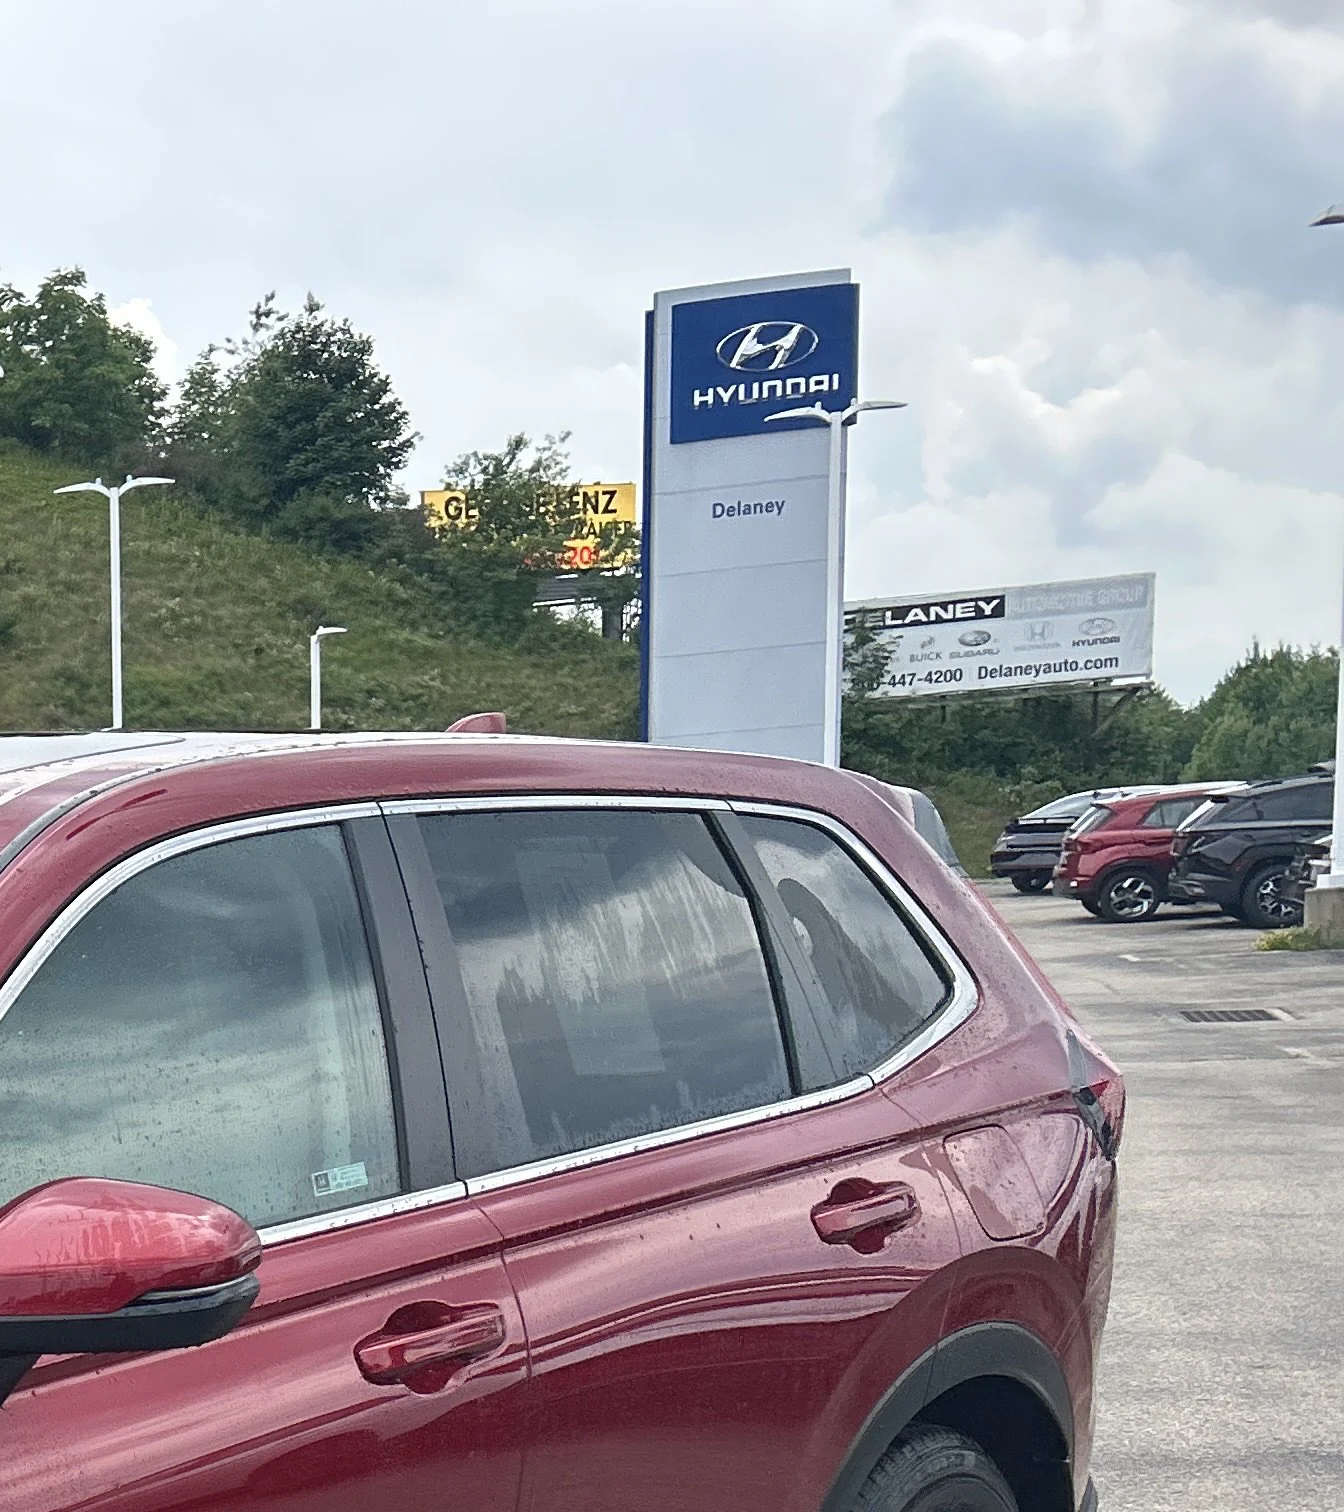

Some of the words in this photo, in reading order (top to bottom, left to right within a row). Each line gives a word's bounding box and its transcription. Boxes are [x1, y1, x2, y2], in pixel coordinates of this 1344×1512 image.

[693, 373, 840, 408] HYUNDAI
[712, 499, 786, 519] Delaney
[1072, 635, 1121, 647] HYUNDAI
[909, 651, 943, 663] BUICK
[949, 648, 1000, 660] SUBARU
[859, 668, 963, 691] -447-4200
[977, 655, 1120, 681] Delaneyauto.com
